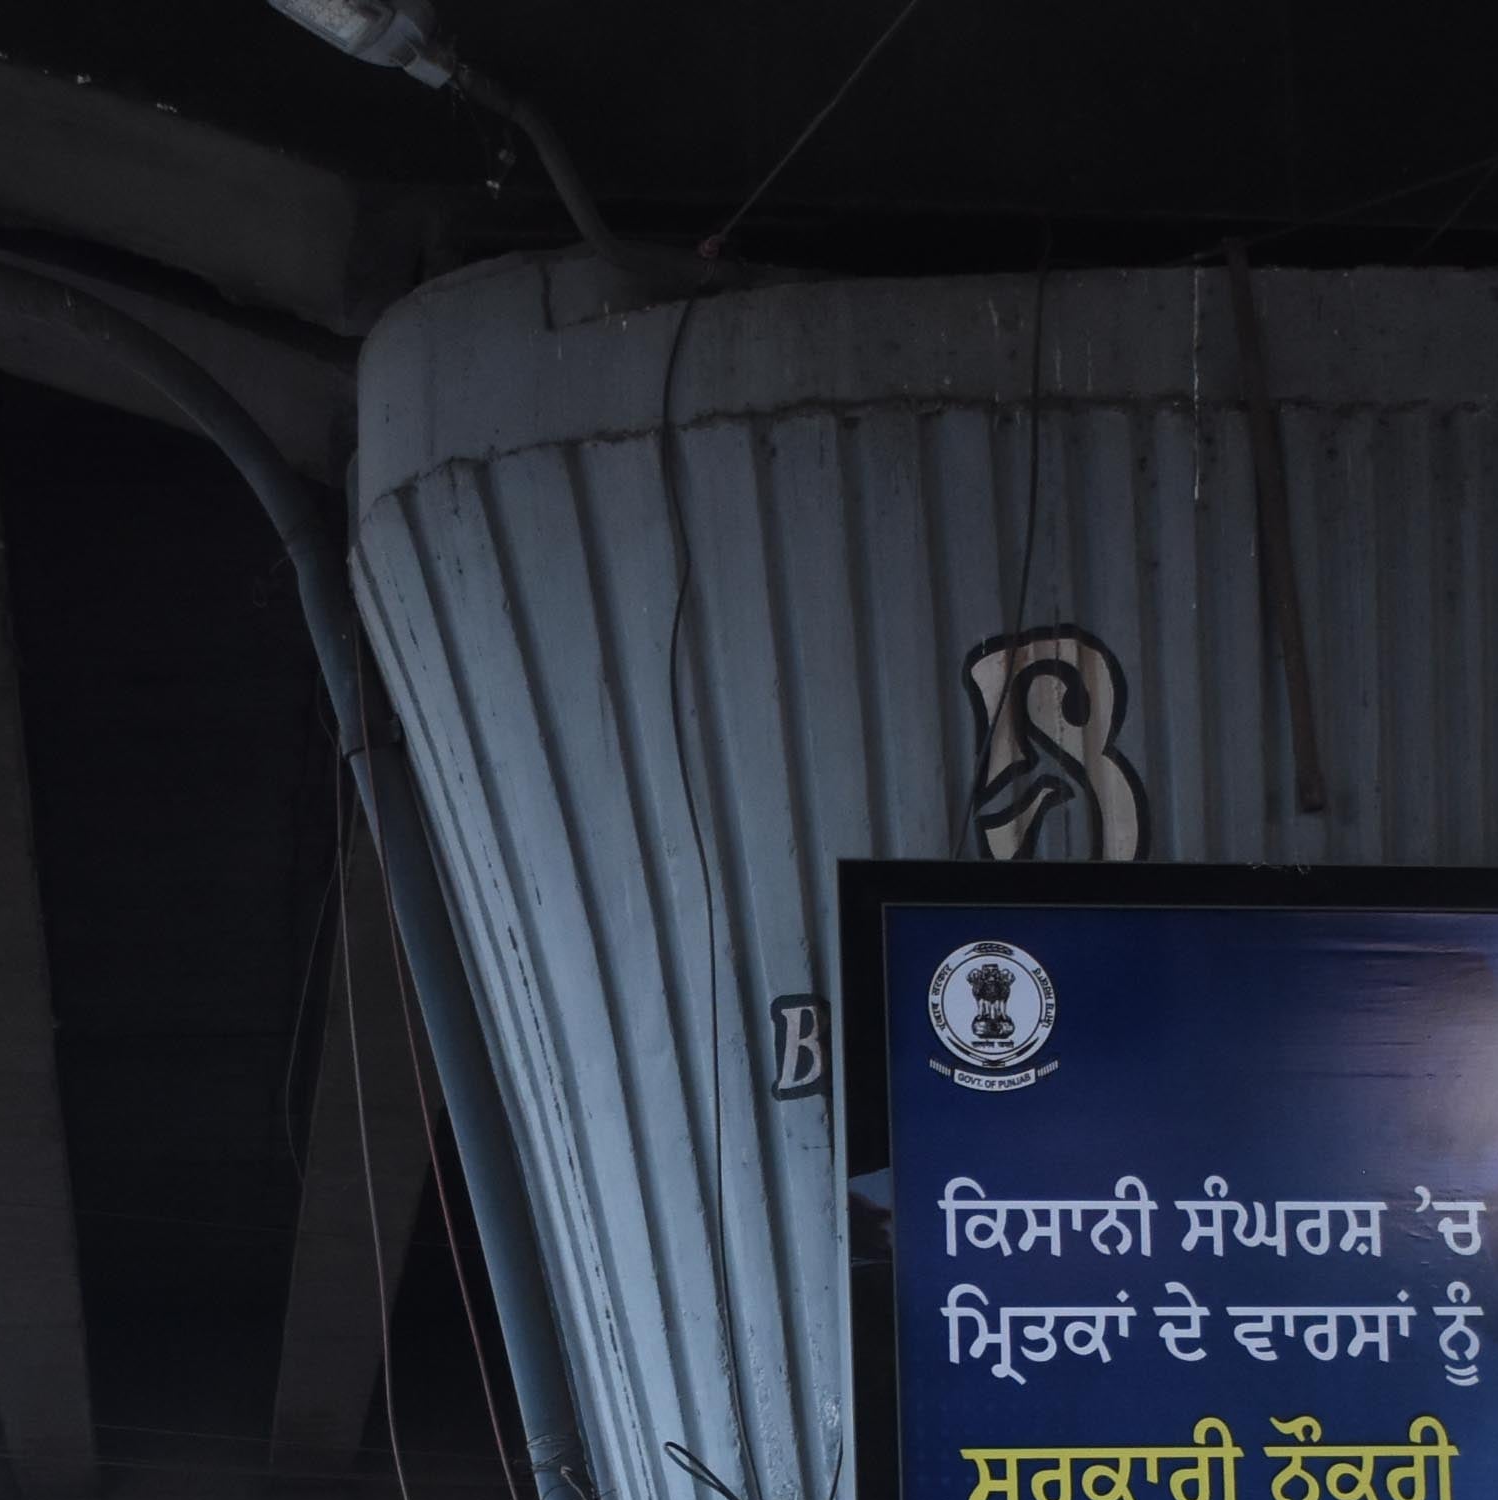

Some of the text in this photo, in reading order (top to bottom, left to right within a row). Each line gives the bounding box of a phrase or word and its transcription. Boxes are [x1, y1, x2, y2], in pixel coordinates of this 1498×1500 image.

[958, 1072, 1032, 1089] GOVT. OF PUNJAB
[937, 1175, 1158, 1258] ਕਿਸਾਨੀ
[1174, 1175, 1388, 1258] ਸੰਘਰਸ਼
[939, 1280, 1484, 1387] ਮ੍ਰਿਤਕਾਂ ਦੇ ਵਾਰਸਾਂ ਨੂੰ
